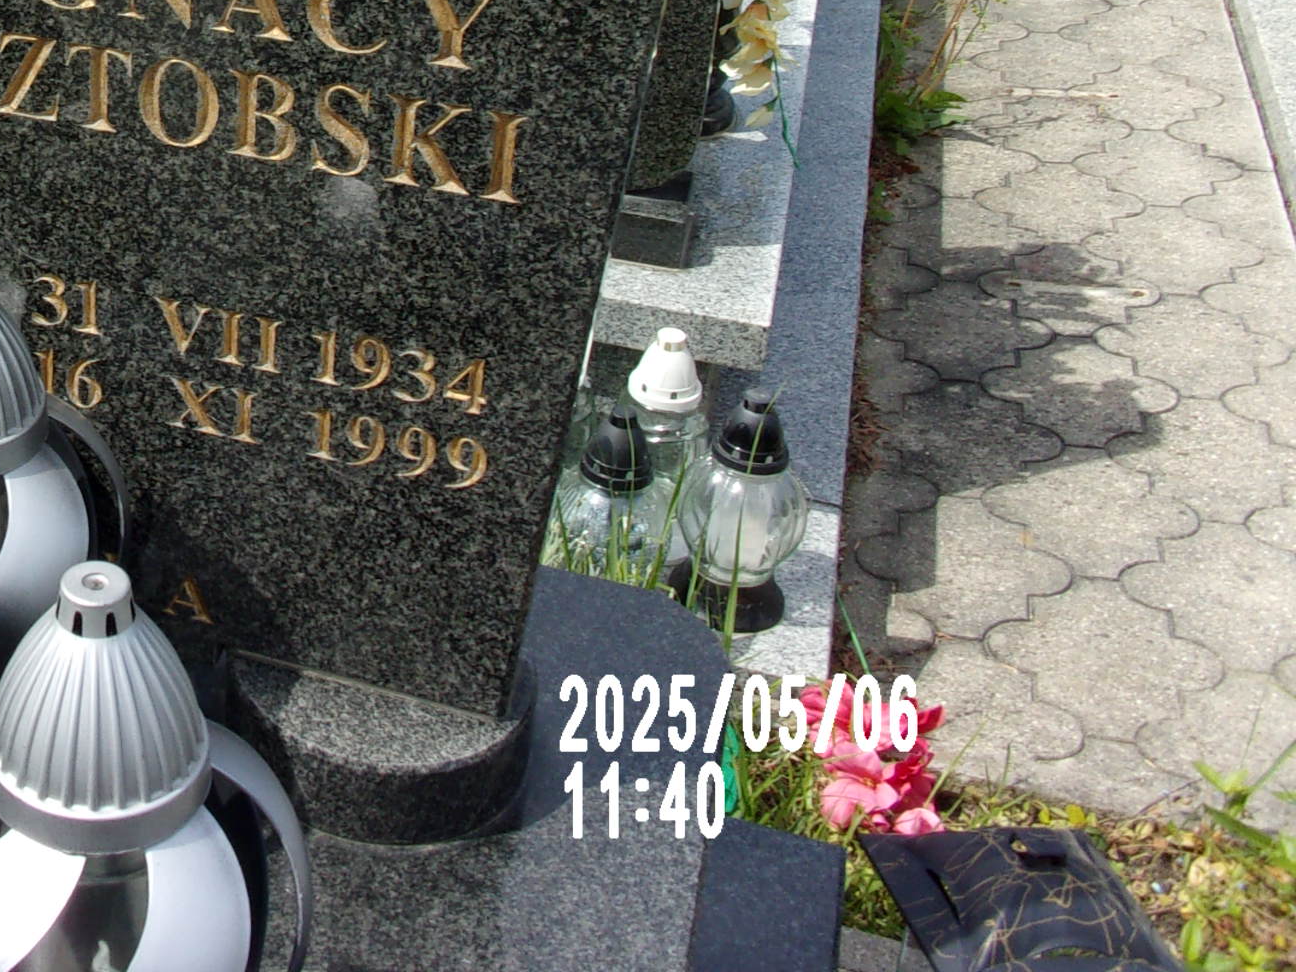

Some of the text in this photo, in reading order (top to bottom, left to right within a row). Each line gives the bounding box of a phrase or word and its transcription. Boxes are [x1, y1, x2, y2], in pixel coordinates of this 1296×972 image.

[31, 274, 489, 416] 31 VII 1934
[35, 348, 489, 491] 16 XI 1999
